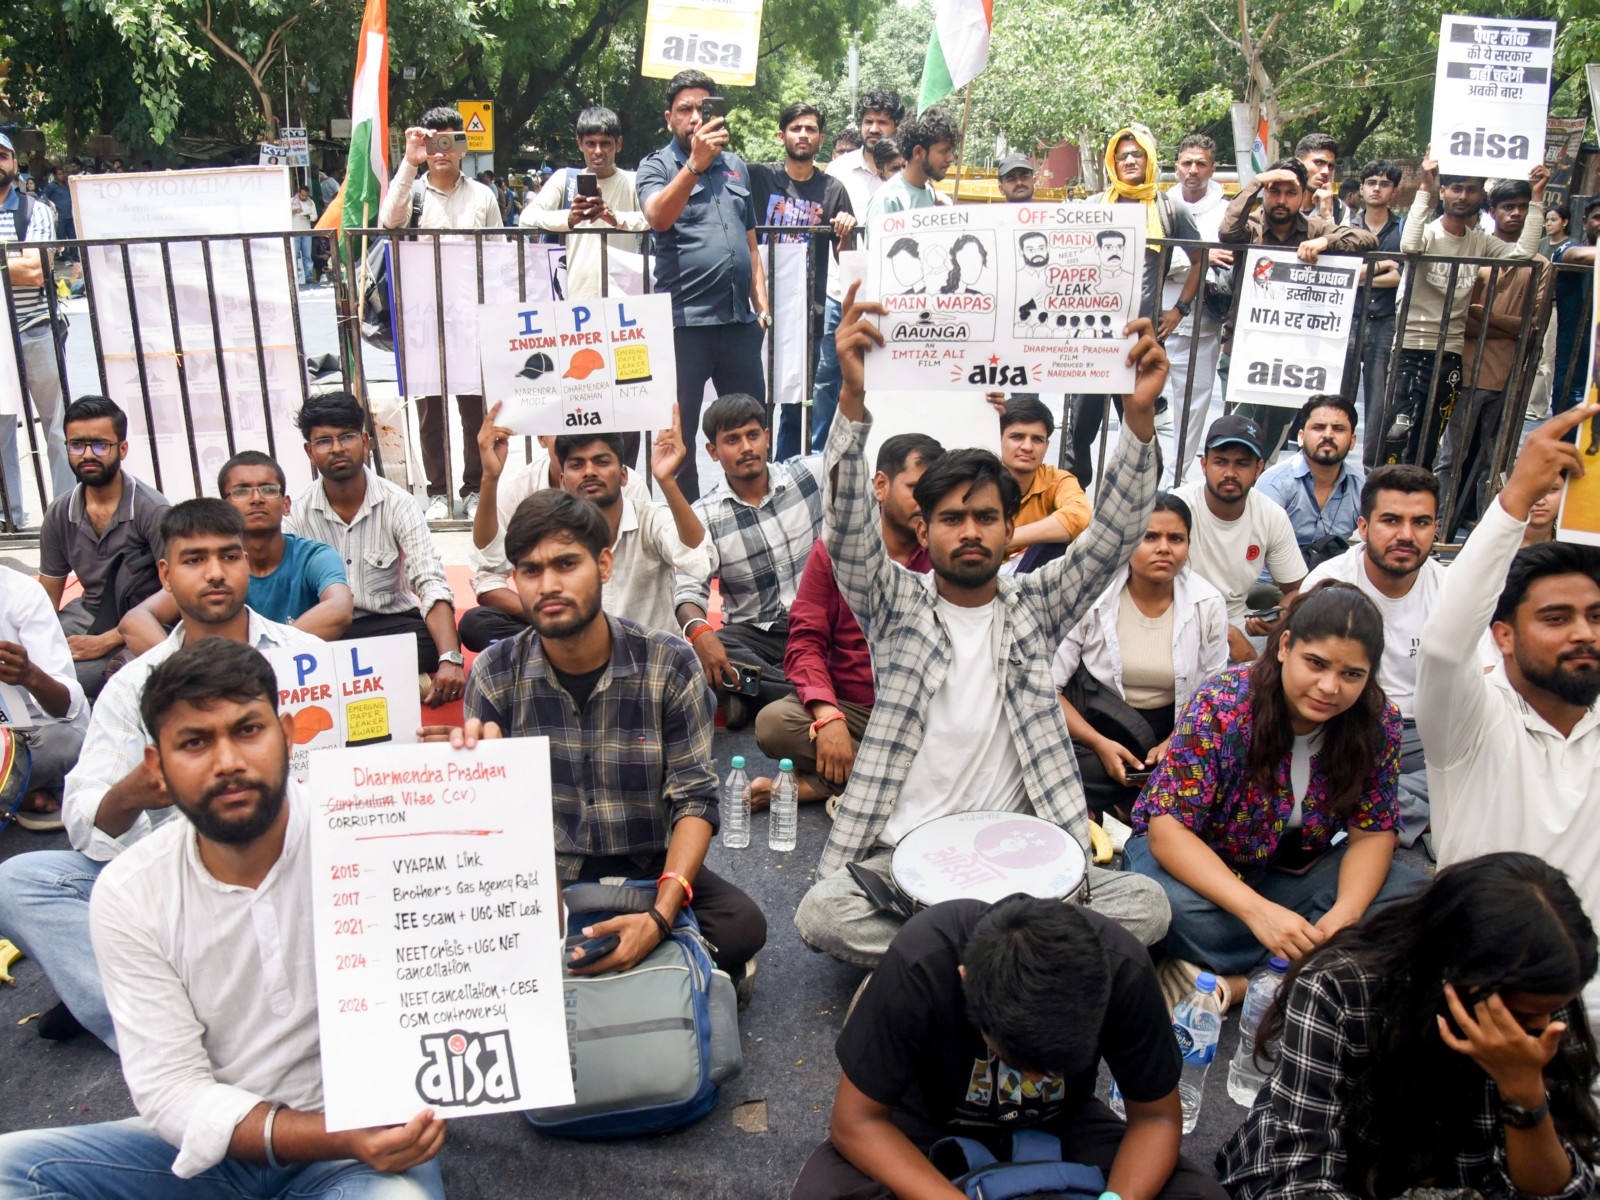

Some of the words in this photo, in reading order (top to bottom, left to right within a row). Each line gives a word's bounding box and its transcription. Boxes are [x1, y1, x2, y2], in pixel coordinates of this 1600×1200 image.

[1473, 26, 1499, 45] पेपर
[1501, 27, 1530, 47] लीक
[662, 33, 742, 68] aisa
[1468, 45, 1480, 59] की
[1484, 46, 1491, 60] ये
[1495, 52, 1532, 62] सरकार
[1469, 65, 1492, 80] नहीं
[1493, 66, 1524, 83] चलेगी
[1468, 84, 1498, 97] अबकी
[1500, 88, 1522, 99] बार!
[263, 147, 286, 155] KYS
[1450, 127, 1529, 160] aisa
[884, 218, 905, 232] ON
[912, 212, 968, 228] SCREEN
[1018, 208, 1113, 224] OFF-SCREEN
[1052, 234, 1092, 245] MAIN
[1059, 251, 1077, 259] NEET
[1050, 268, 1097, 283] PAPER
[1318, 273, 1349, 286] प्रधान
[1056, 284, 1091, 296] LEAK
[1286, 286, 1327, 303] इस्तीफा
[1329, 289, 1344, 305] दो!
[885, 297, 926, 309] MAIN
[937, 297, 992, 310] WAPAS
[1048, 296, 1119, 309] KARAUNGA
[518, 310, 542, 335] I
[572, 306, 590, 332] P
[618, 303, 636, 327] L
[1250, 307, 1280, 325] NTA
[1284, 311, 1304, 329] रद्द
[1307, 312, 1341, 332] करो!
[509, 336, 556, 351] INDIAN
[560, 332, 602, 346] PAPER
[611, 328, 645, 342] LEAK
[895, 326, 967, 338] AAUNGA
[892, 350, 938, 359] IMTIAZ
[943, 350, 965, 358] ALI
[1023, 345, 1078, 353] DHARMENDRA
[1083, 345, 1119, 353] PRADHAN
[618, 361, 646, 369] LEAKER
[620, 368, 644, 376] AWARD
[968, 362, 1028, 387] aisa
[1090, 370, 1110, 378] MODI
[1247, 358, 1327, 391] aisa
[515, 387, 557, 396] NARENDRA
[563, 382, 610, 394] DHARMENDRA
[620, 386, 648, 398] NTA
[521, 397, 546, 406] MODI
[569, 392, 602, 402] PRADHAN
[565, 411, 602, 427] aisa
[293, 654, 317, 686] P
[351, 647, 373, 677] L
[278, 684, 332, 705] PAPER
[343, 676, 384, 696] LEAK
[349, 702, 385, 713] EMERGING
[350, 711, 381, 721] PAPER
[350, 718, 384, 729] LEAKER
[351, 726, 383, 737] AWARD
[353, 764, 444, 787] Dharmendra
[448, 762, 506, 781] Pradhan
[401, 791, 436, 806] Vitae
[329, 811, 406, 829] CORRUPTION
[331, 864, 360, 880] 2015
[393, 856, 447, 874] VYAPAM
[456, 852, 483, 869] Link
[333, 892, 359, 906] 2017
[393, 883, 451, 902] Brother's
[457, 881, 475, 894] Gas
[479, 878, 513, 897] Agency
[515, 872, 539, 888] Raid
[334, 920, 364, 934] 2021
[394, 912, 418, 930] JEE
[459, 911, 466, 921] +
[520, 900, 542, 917] Leak
[336, 954, 366, 970] 2024
[397, 945, 428, 963] NEET
[430, 940, 464, 958] crisis
[474, 939, 496, 954] UGC
[499, 933, 520, 950] NET
[339, 999, 368, 1013] 2026
[400, 991, 429, 1008] NEET
[431, 982, 500, 1004] cancellation
[510, 979, 539, 995] CBSE
[400, 1012, 429, 1028] OSM
[433, 1004, 508, 1024] controversy
[416, 1029, 521, 1106] aisa
